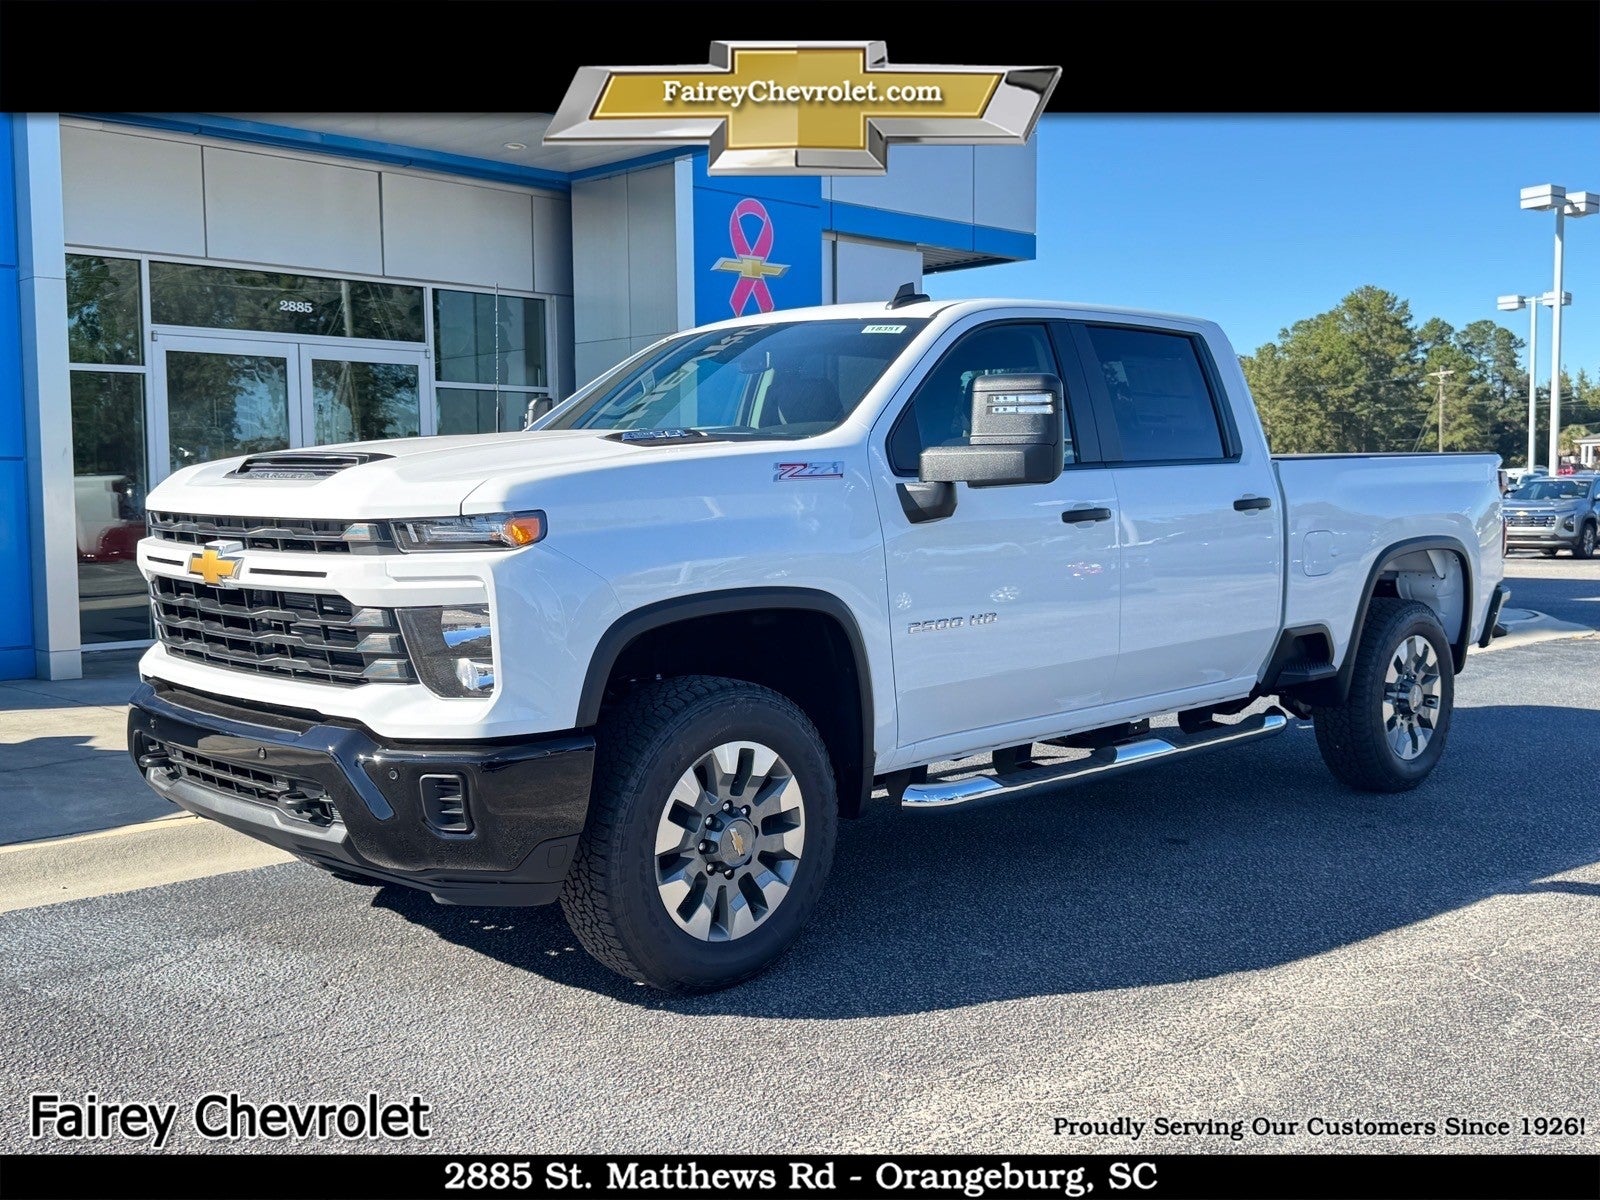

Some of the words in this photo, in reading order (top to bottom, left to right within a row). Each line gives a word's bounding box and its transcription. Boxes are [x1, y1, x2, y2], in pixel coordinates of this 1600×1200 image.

[279, 300, 313, 313] 2885
[907, 617, 964, 635] 2500
[969, 612, 998, 627] HD
